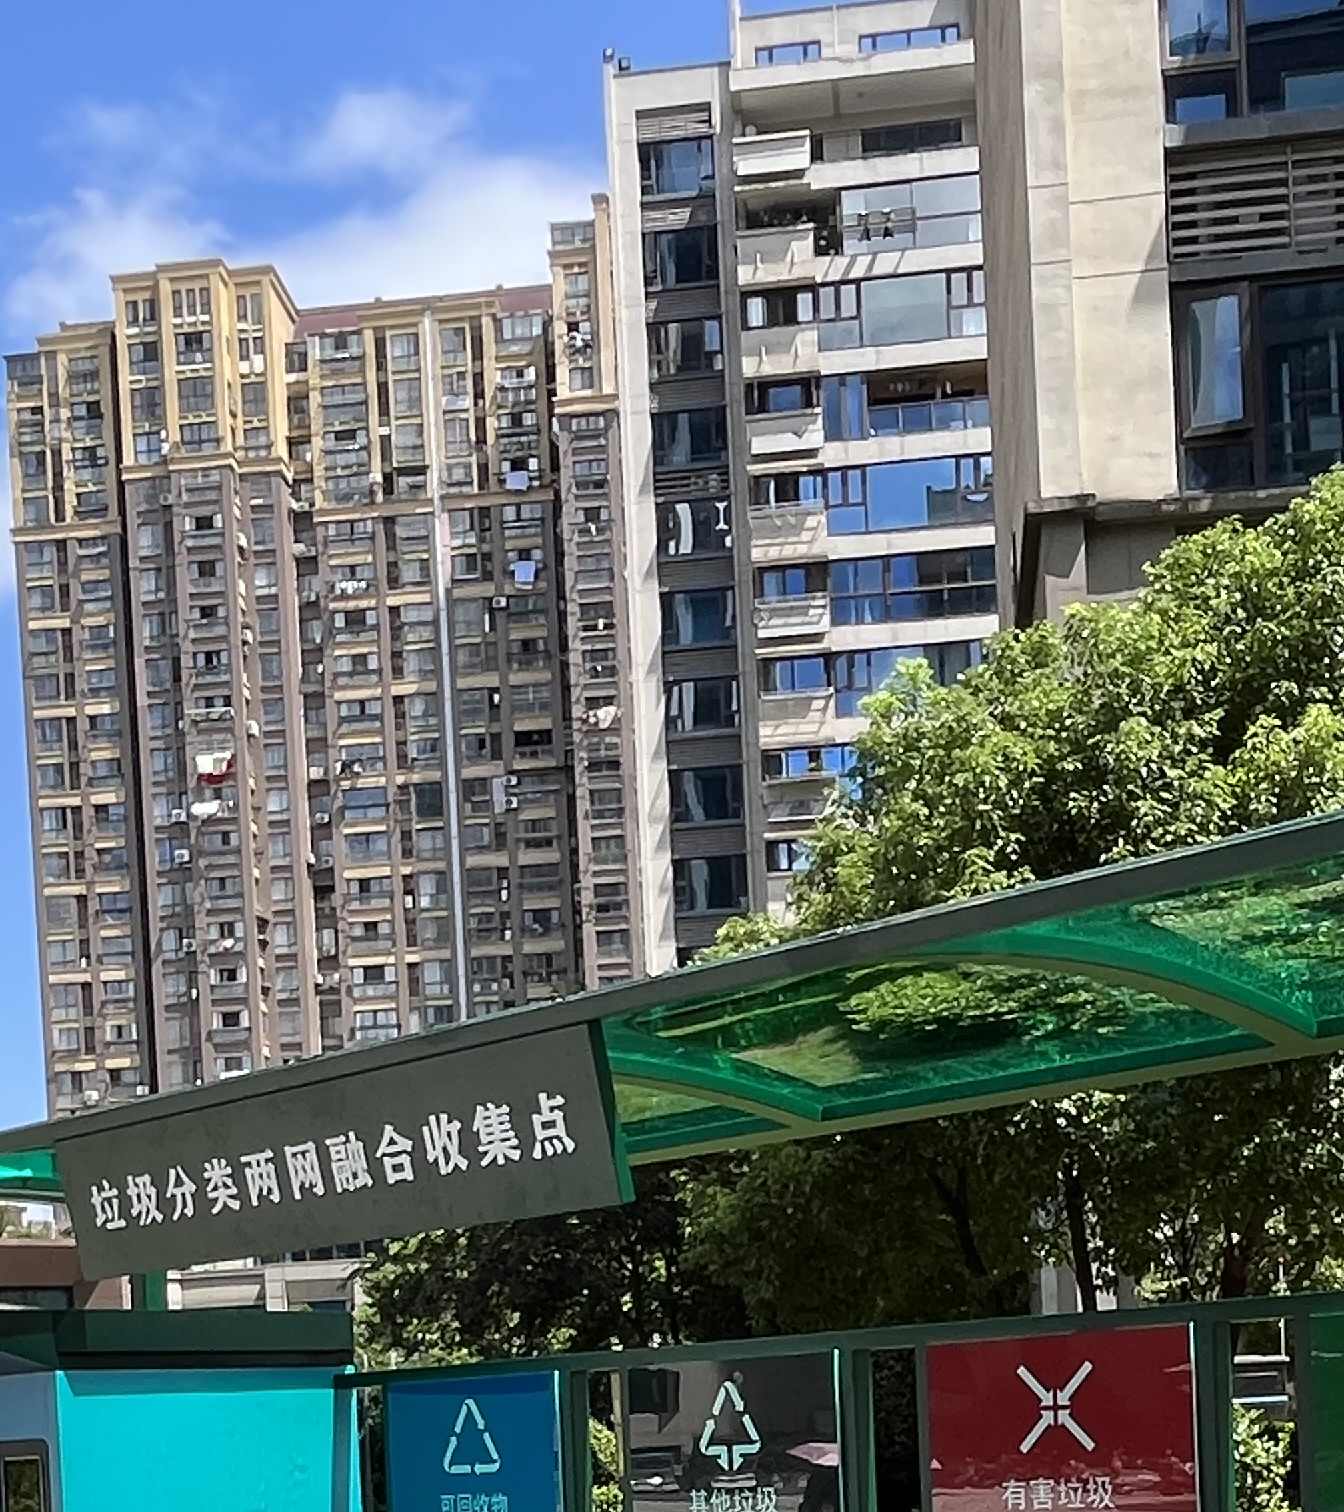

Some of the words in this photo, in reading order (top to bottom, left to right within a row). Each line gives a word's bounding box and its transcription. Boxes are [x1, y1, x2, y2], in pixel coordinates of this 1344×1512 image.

[90, 1092, 577, 1231] 垃圾分类两网融合收集点
[1001, 1476, 1115, 1510] 有害垃圾
